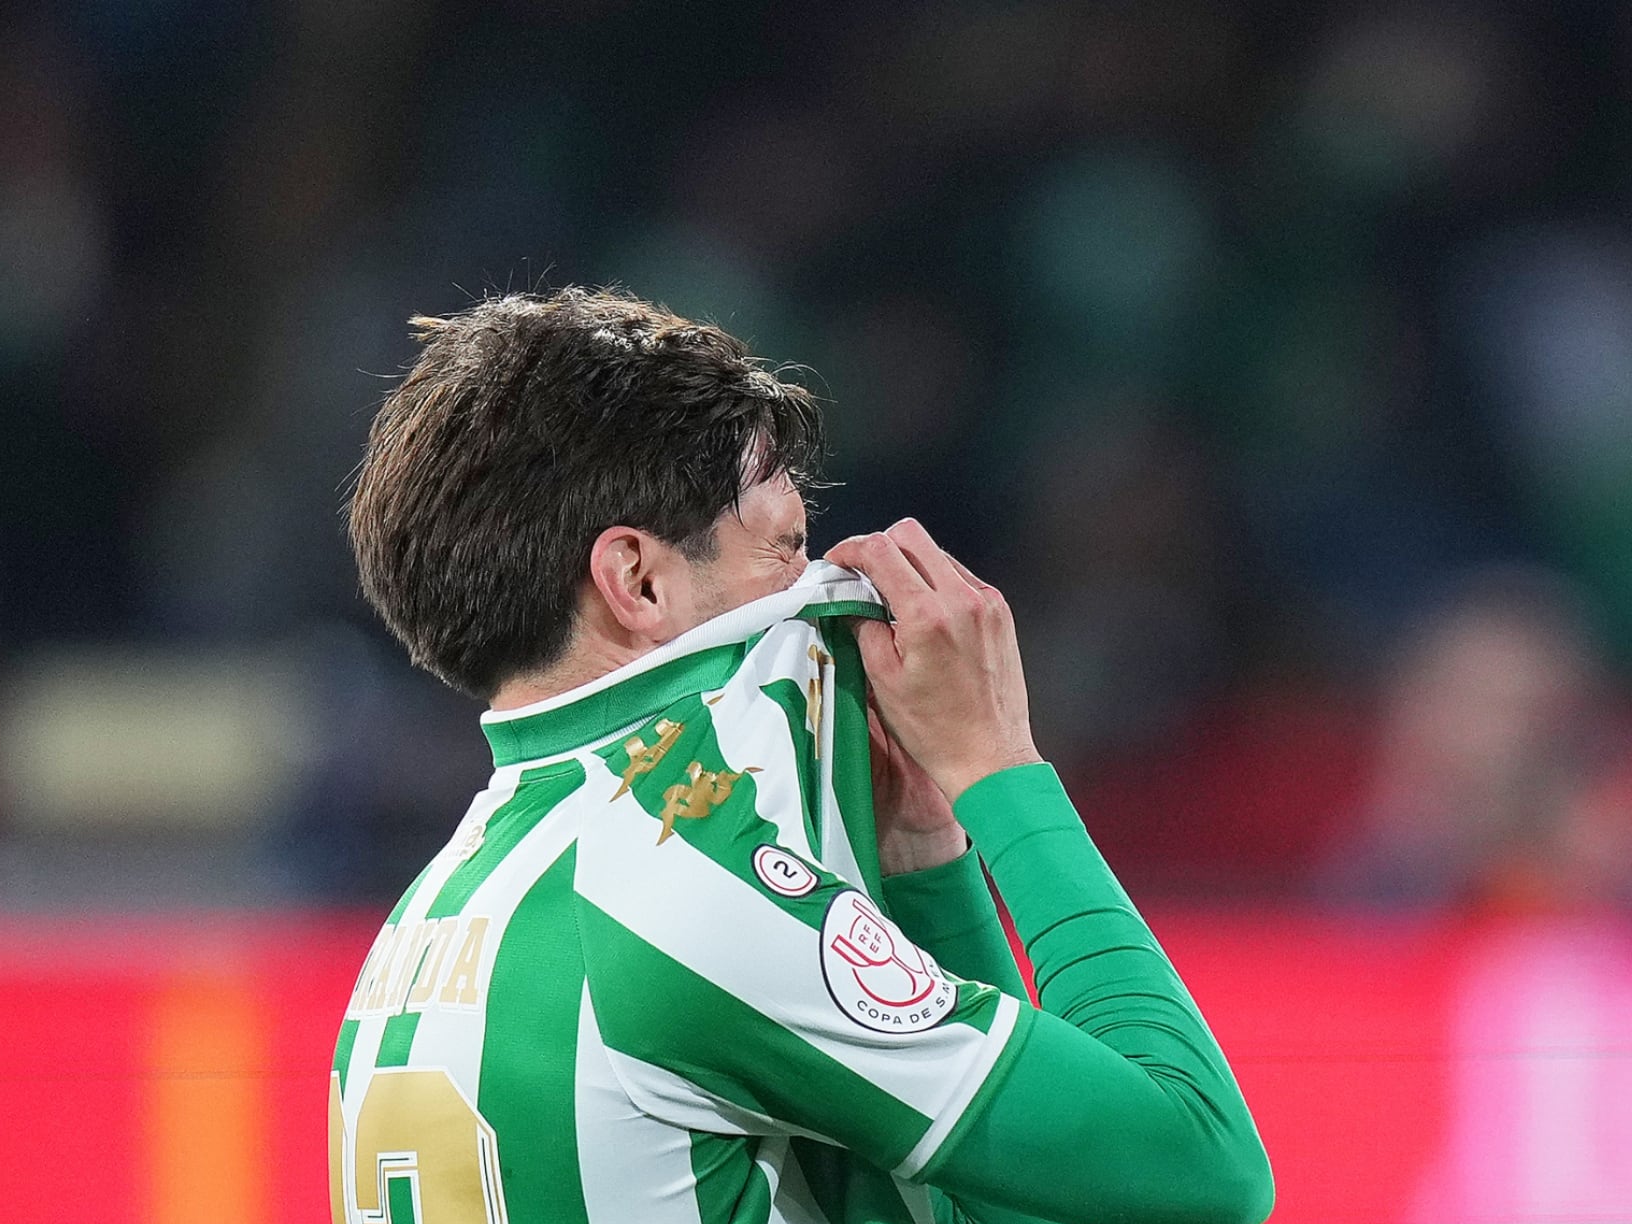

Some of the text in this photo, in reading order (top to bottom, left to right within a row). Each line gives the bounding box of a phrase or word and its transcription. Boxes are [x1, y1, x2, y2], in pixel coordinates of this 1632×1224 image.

[773, 860, 798, 879] 2
[348, 917, 491, 1011] RANDA
[856, 982, 951, 1025] COPA DE S.M
